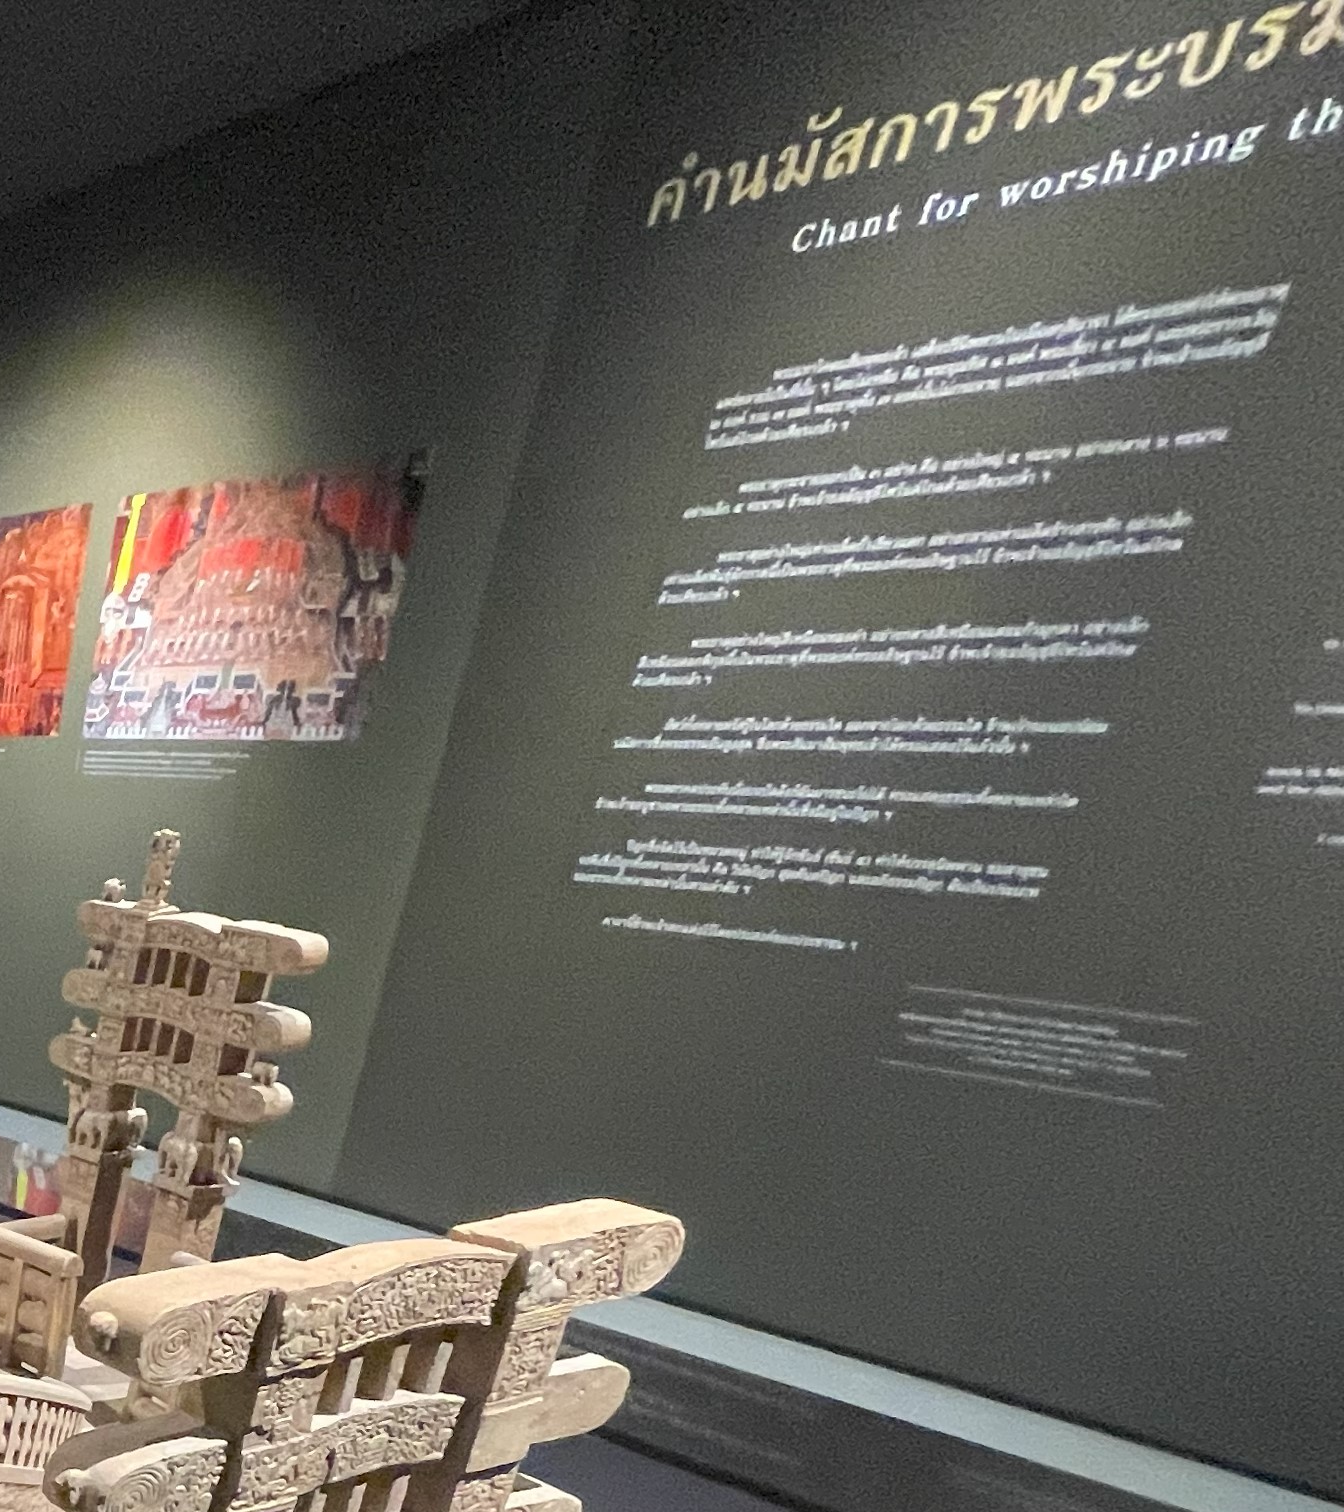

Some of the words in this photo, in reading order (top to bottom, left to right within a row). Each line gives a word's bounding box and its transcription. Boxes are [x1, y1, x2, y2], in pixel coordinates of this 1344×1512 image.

[791, 203, 903, 254] Chant
[916, 187, 980, 228] for
[999, 123, 1267, 209] worshiping
